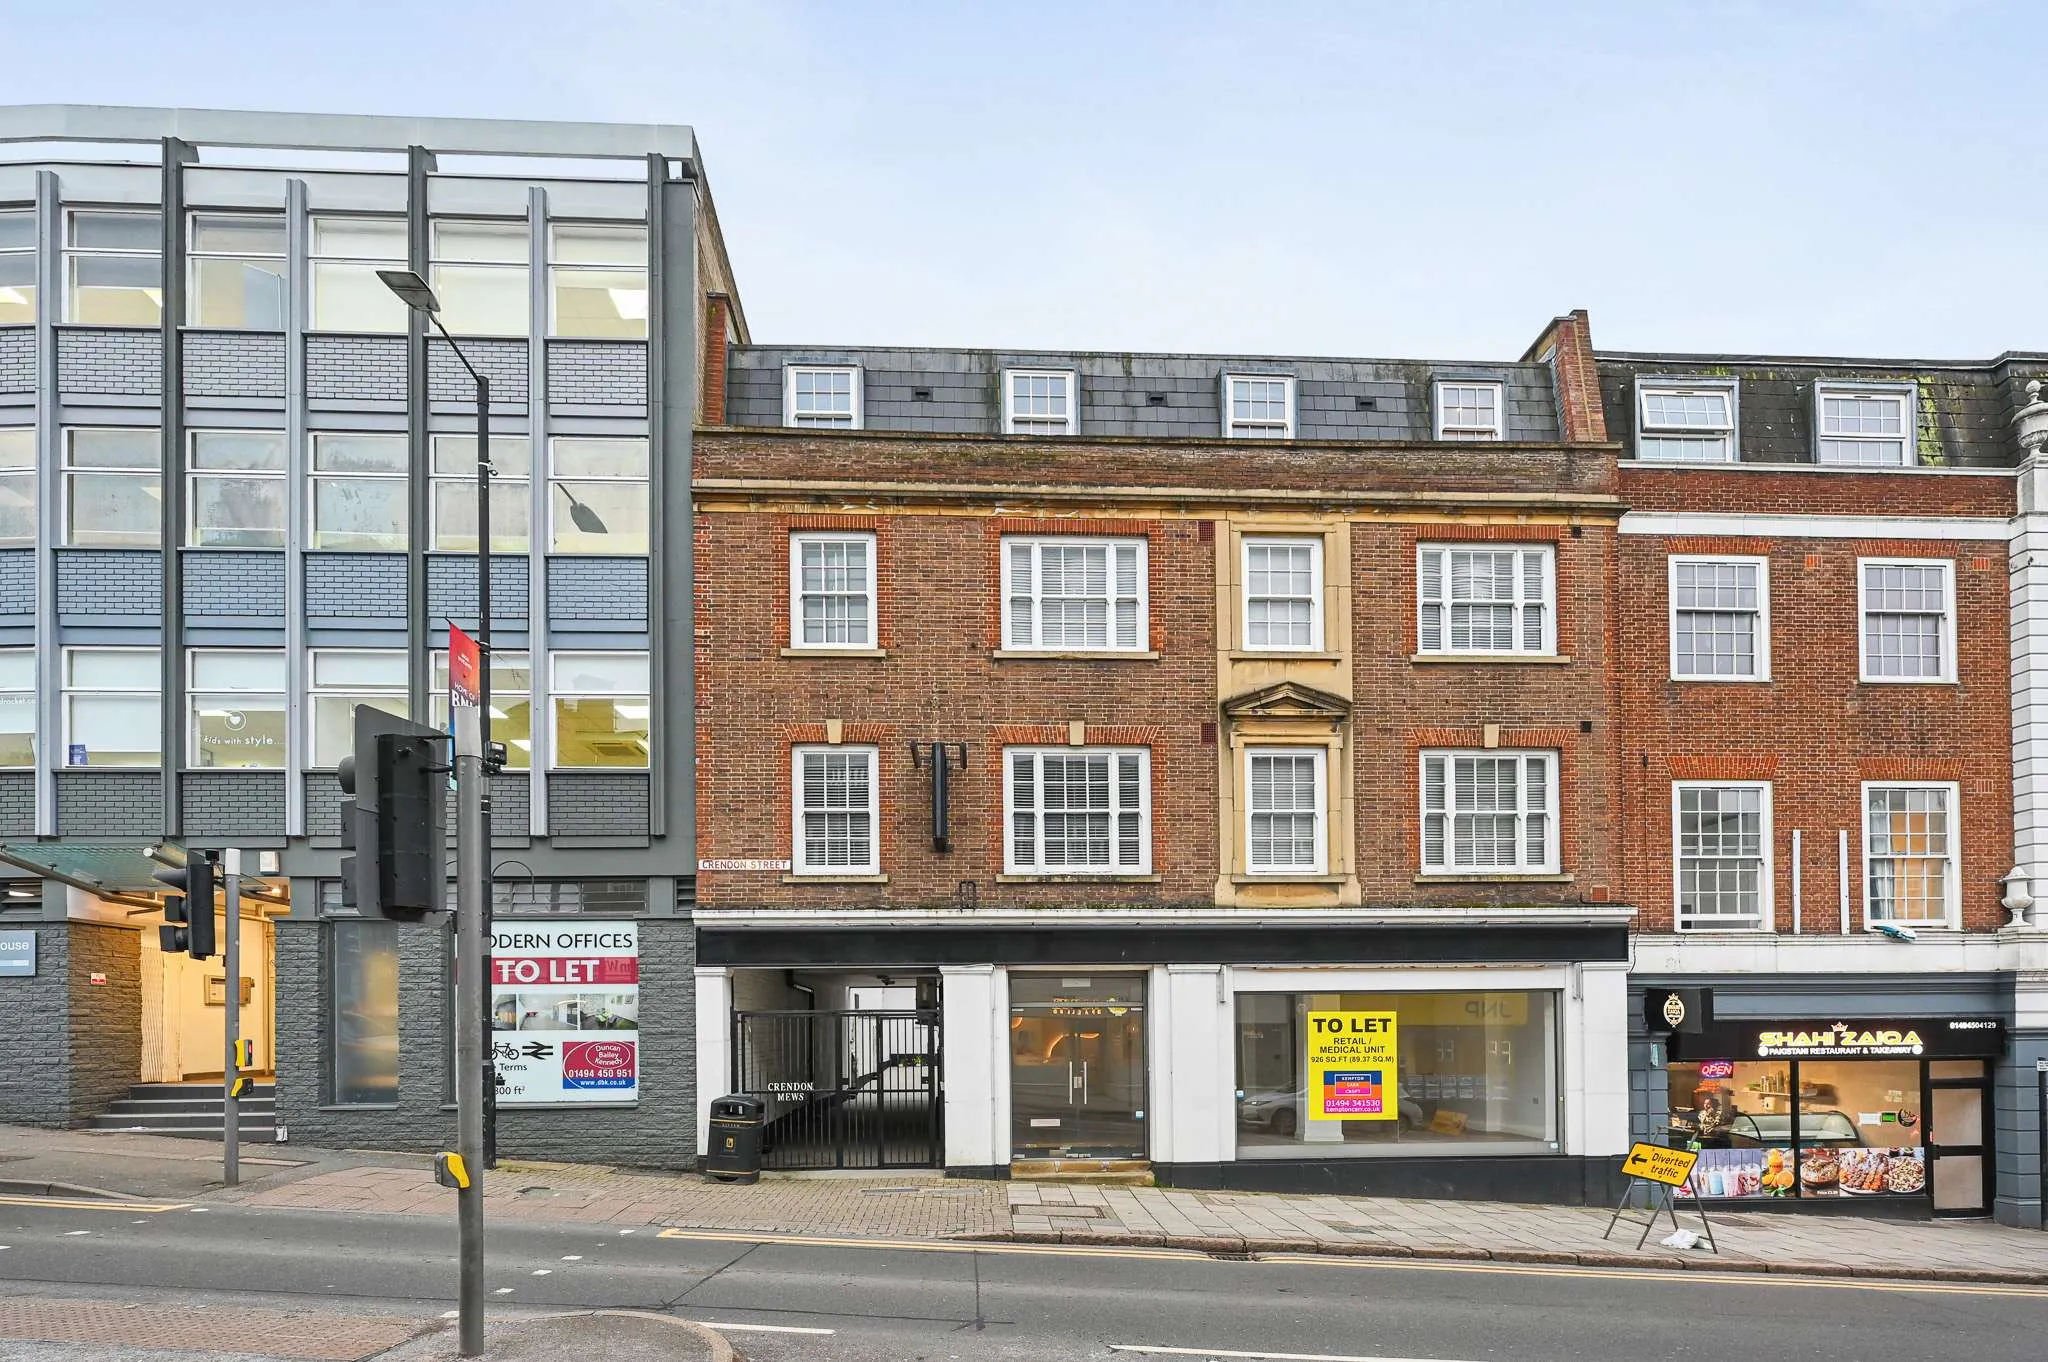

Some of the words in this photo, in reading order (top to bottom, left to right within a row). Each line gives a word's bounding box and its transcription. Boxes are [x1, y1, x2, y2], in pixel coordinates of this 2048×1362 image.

[204, 736, 220, 745] kids
[224, 737, 241, 745] with
[702, 861, 747, 869] CRENDON
[750, 861, 787, 869] STREET
[491, 934, 550, 948] DERN
[557, 933, 633, 948] OFFICES
[0, 941, 29, 951] ouse
[495, 960, 540, 983] TO
[550, 960, 600, 982] LET
[1313, 1018, 1343, 1033] TO
[1351, 1018, 1392, 1033] LET
[1333, 1037, 1366, 1045] RETAIL
[1759, 1031, 1835, 1047] SHAHI
[1840, 1030, 1924, 1046] ZAIQA
[1320, 1046, 1361, 1054] MEDICAL
[1769, 1047, 1809, 1055] PAKISTANI
[1810, 1047, 1861, 1055] RESTAURANT
[1869, 1046, 1912, 1054] TAKEAWAY
[595, 1058, 623, 1066] Kennedy
[500, 1063, 527, 1071] Terms
[1701, 1065, 1733, 1075] OPEN
[568, 1069, 594, 1078] 01494
[597, 1069, 614, 1077] 450
[616, 1069, 632, 1077] 951
[767, 1082, 814, 1092] CRENDON
[777, 1093, 805, 1101] MEWS
[1651, 1153, 1690, 1168] Diverted
[1651, 1165, 1679, 1178] traffic
